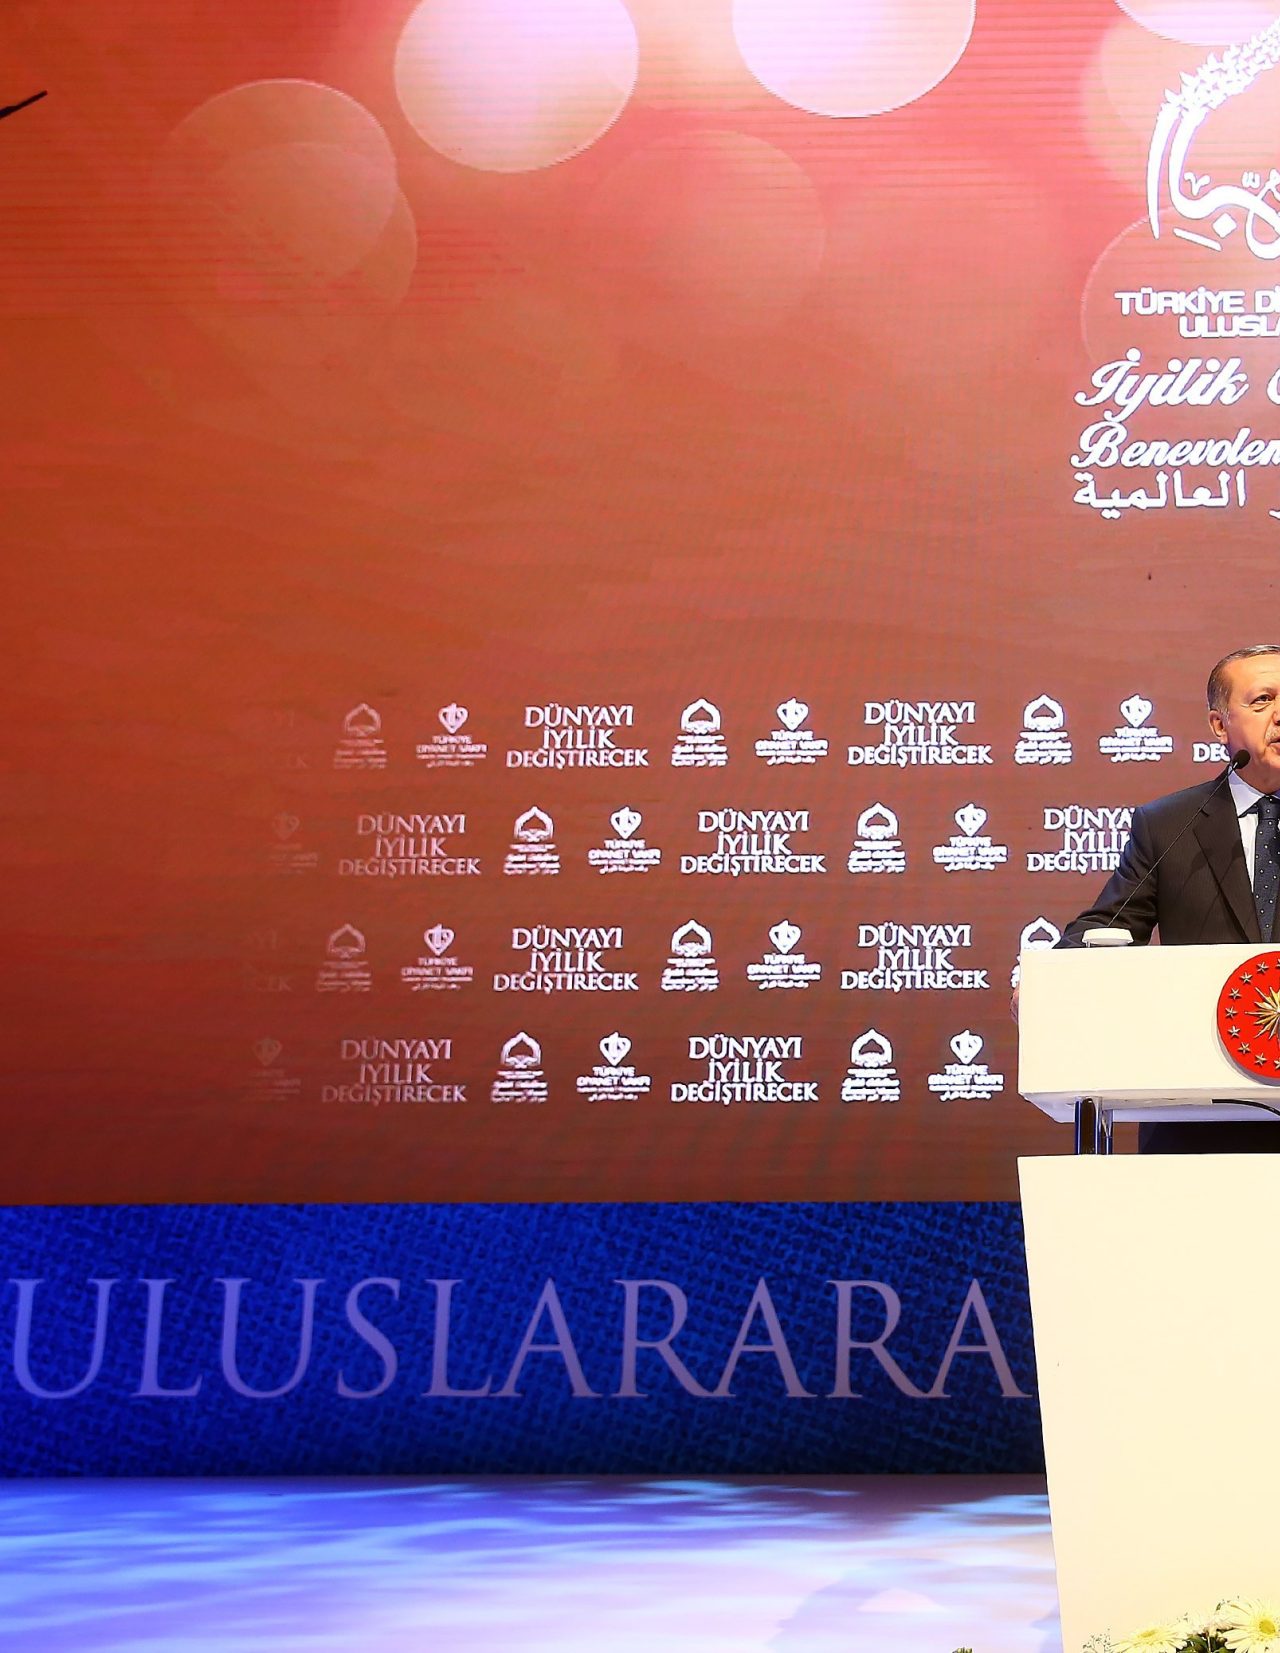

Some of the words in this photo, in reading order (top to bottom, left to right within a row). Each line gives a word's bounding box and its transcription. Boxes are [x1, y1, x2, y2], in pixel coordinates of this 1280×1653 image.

[1115, 287, 1246, 315] TÜRKİYE
[1074, 348, 1249, 422] İyilik
[1073, 468, 1246, 520] العالمية
[523, 702, 634, 727] DÜNYAYI
[864, 699, 976, 724] DÜNYAYI
[542, 725, 617, 749] İYİLİK
[884, 722, 959, 746] İYİLİK
[697, 807, 810, 833] DÜNYAYI
[1044, 805, 1135, 829] DÜNYA
[717, 831, 792, 855] İYİLİK
[1027, 849, 1120, 874] DEĞİŞTİR
[511, 924, 624, 950] DÜNYAYI
[858, 922, 972, 948] DÜNYAYI
[530, 948, 606, 973] İYİLİK
[878, 945, 954, 970] İYİLİK
[688, 1033, 803, 1060] DÜNYAYI
[708, 1057, 785, 1083] İYİLİK
[6, 1277, 1033, 1400] ULUSLARARA
